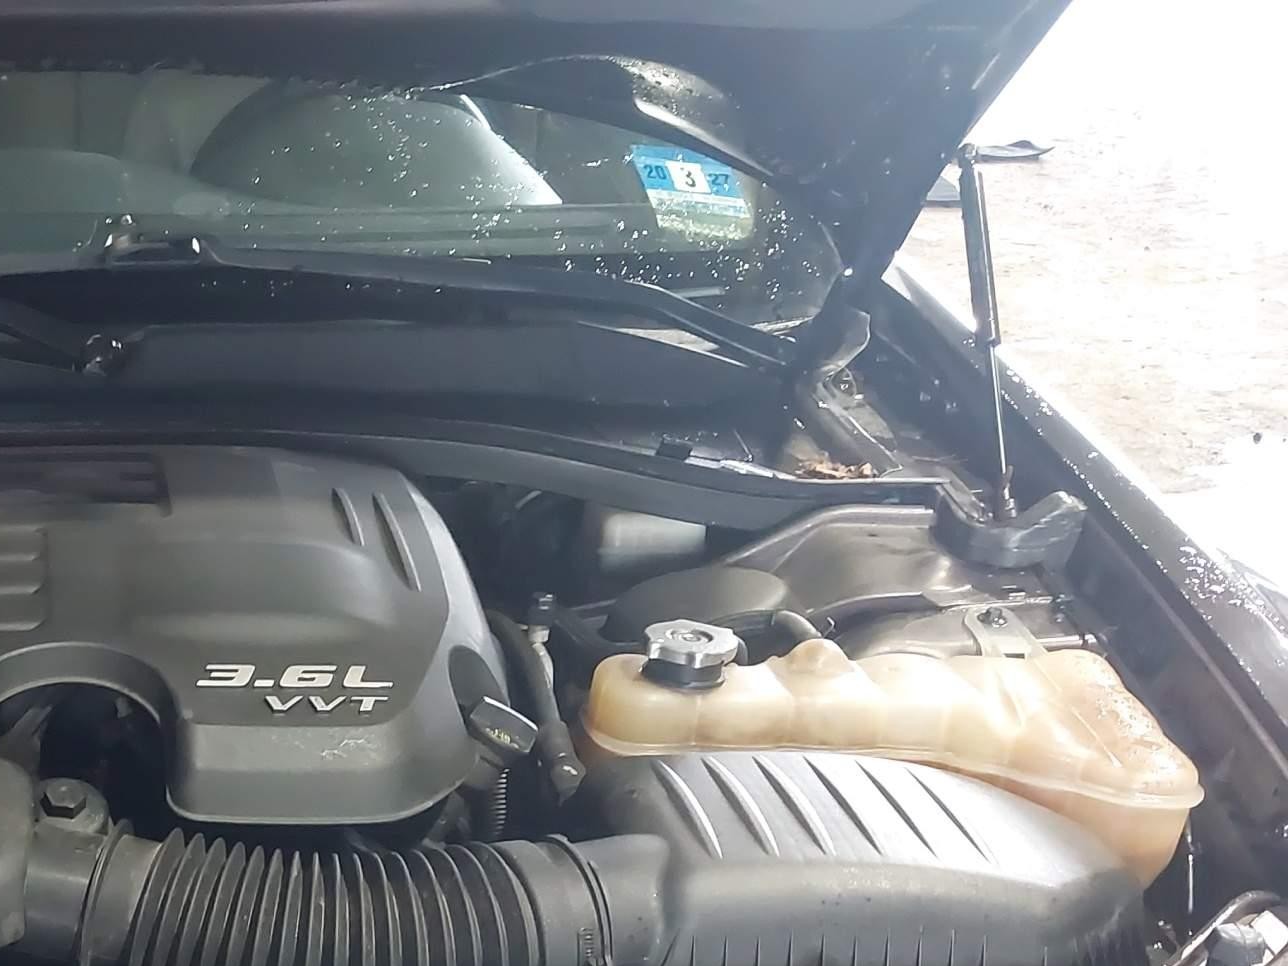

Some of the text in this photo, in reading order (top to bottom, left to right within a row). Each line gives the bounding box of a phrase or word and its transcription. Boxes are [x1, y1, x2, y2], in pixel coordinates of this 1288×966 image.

[643, 164, 730, 187] 20 3 27
[196, 664, 394, 688] 3.6L
[265, 695, 389, 712] VVT
